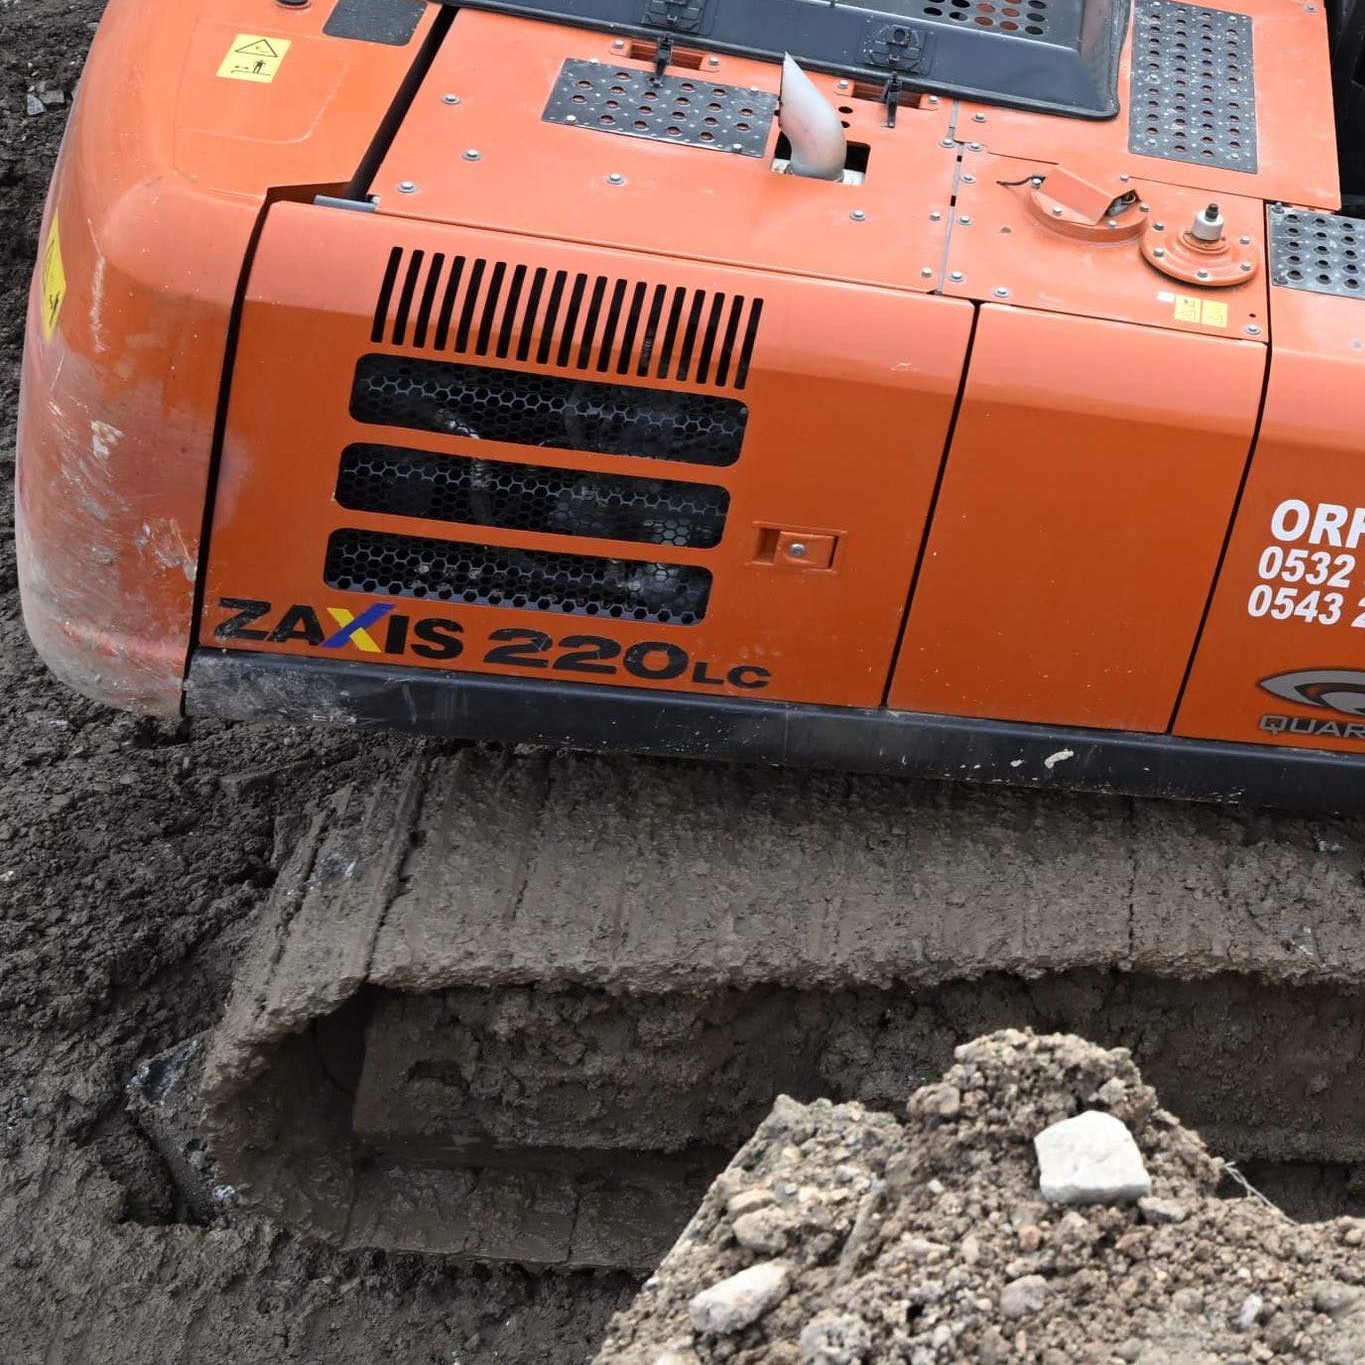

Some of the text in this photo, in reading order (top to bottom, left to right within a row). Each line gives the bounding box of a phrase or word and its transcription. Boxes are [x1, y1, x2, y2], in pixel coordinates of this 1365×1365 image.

[1258, 546, 1355, 588] 0532
[1247, 584, 1344, 625] 0543
[214, 597, 464, 660] ZAXIS
